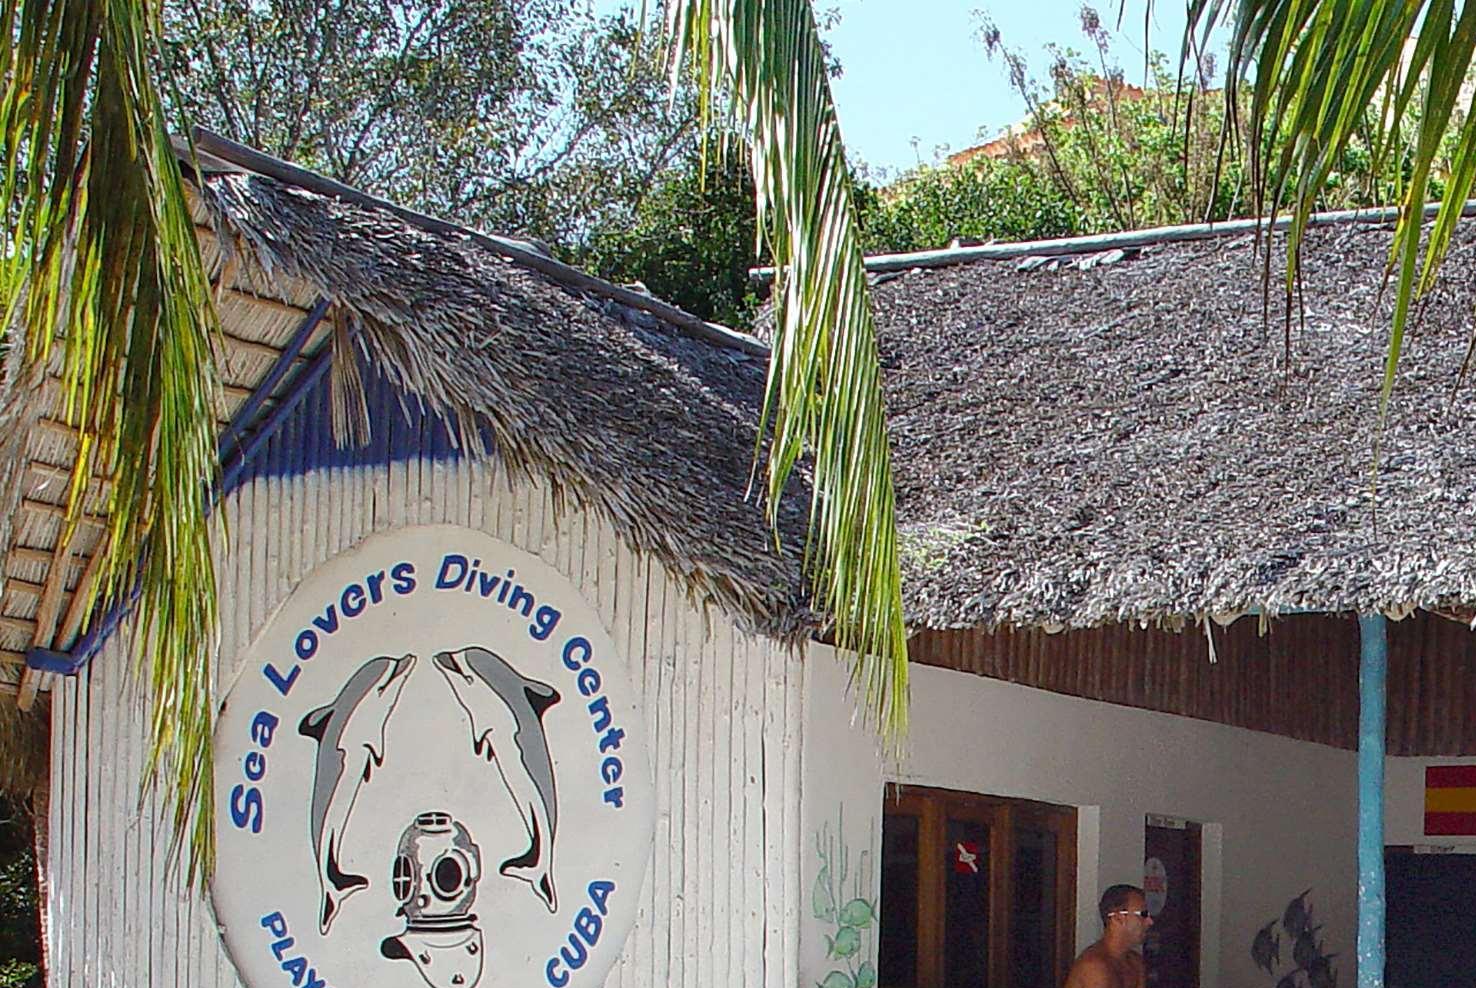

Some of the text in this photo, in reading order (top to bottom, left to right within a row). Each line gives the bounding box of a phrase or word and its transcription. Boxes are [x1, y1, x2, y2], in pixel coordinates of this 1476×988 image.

[231, 554, 625, 834] Sea Lovers Diving Center
